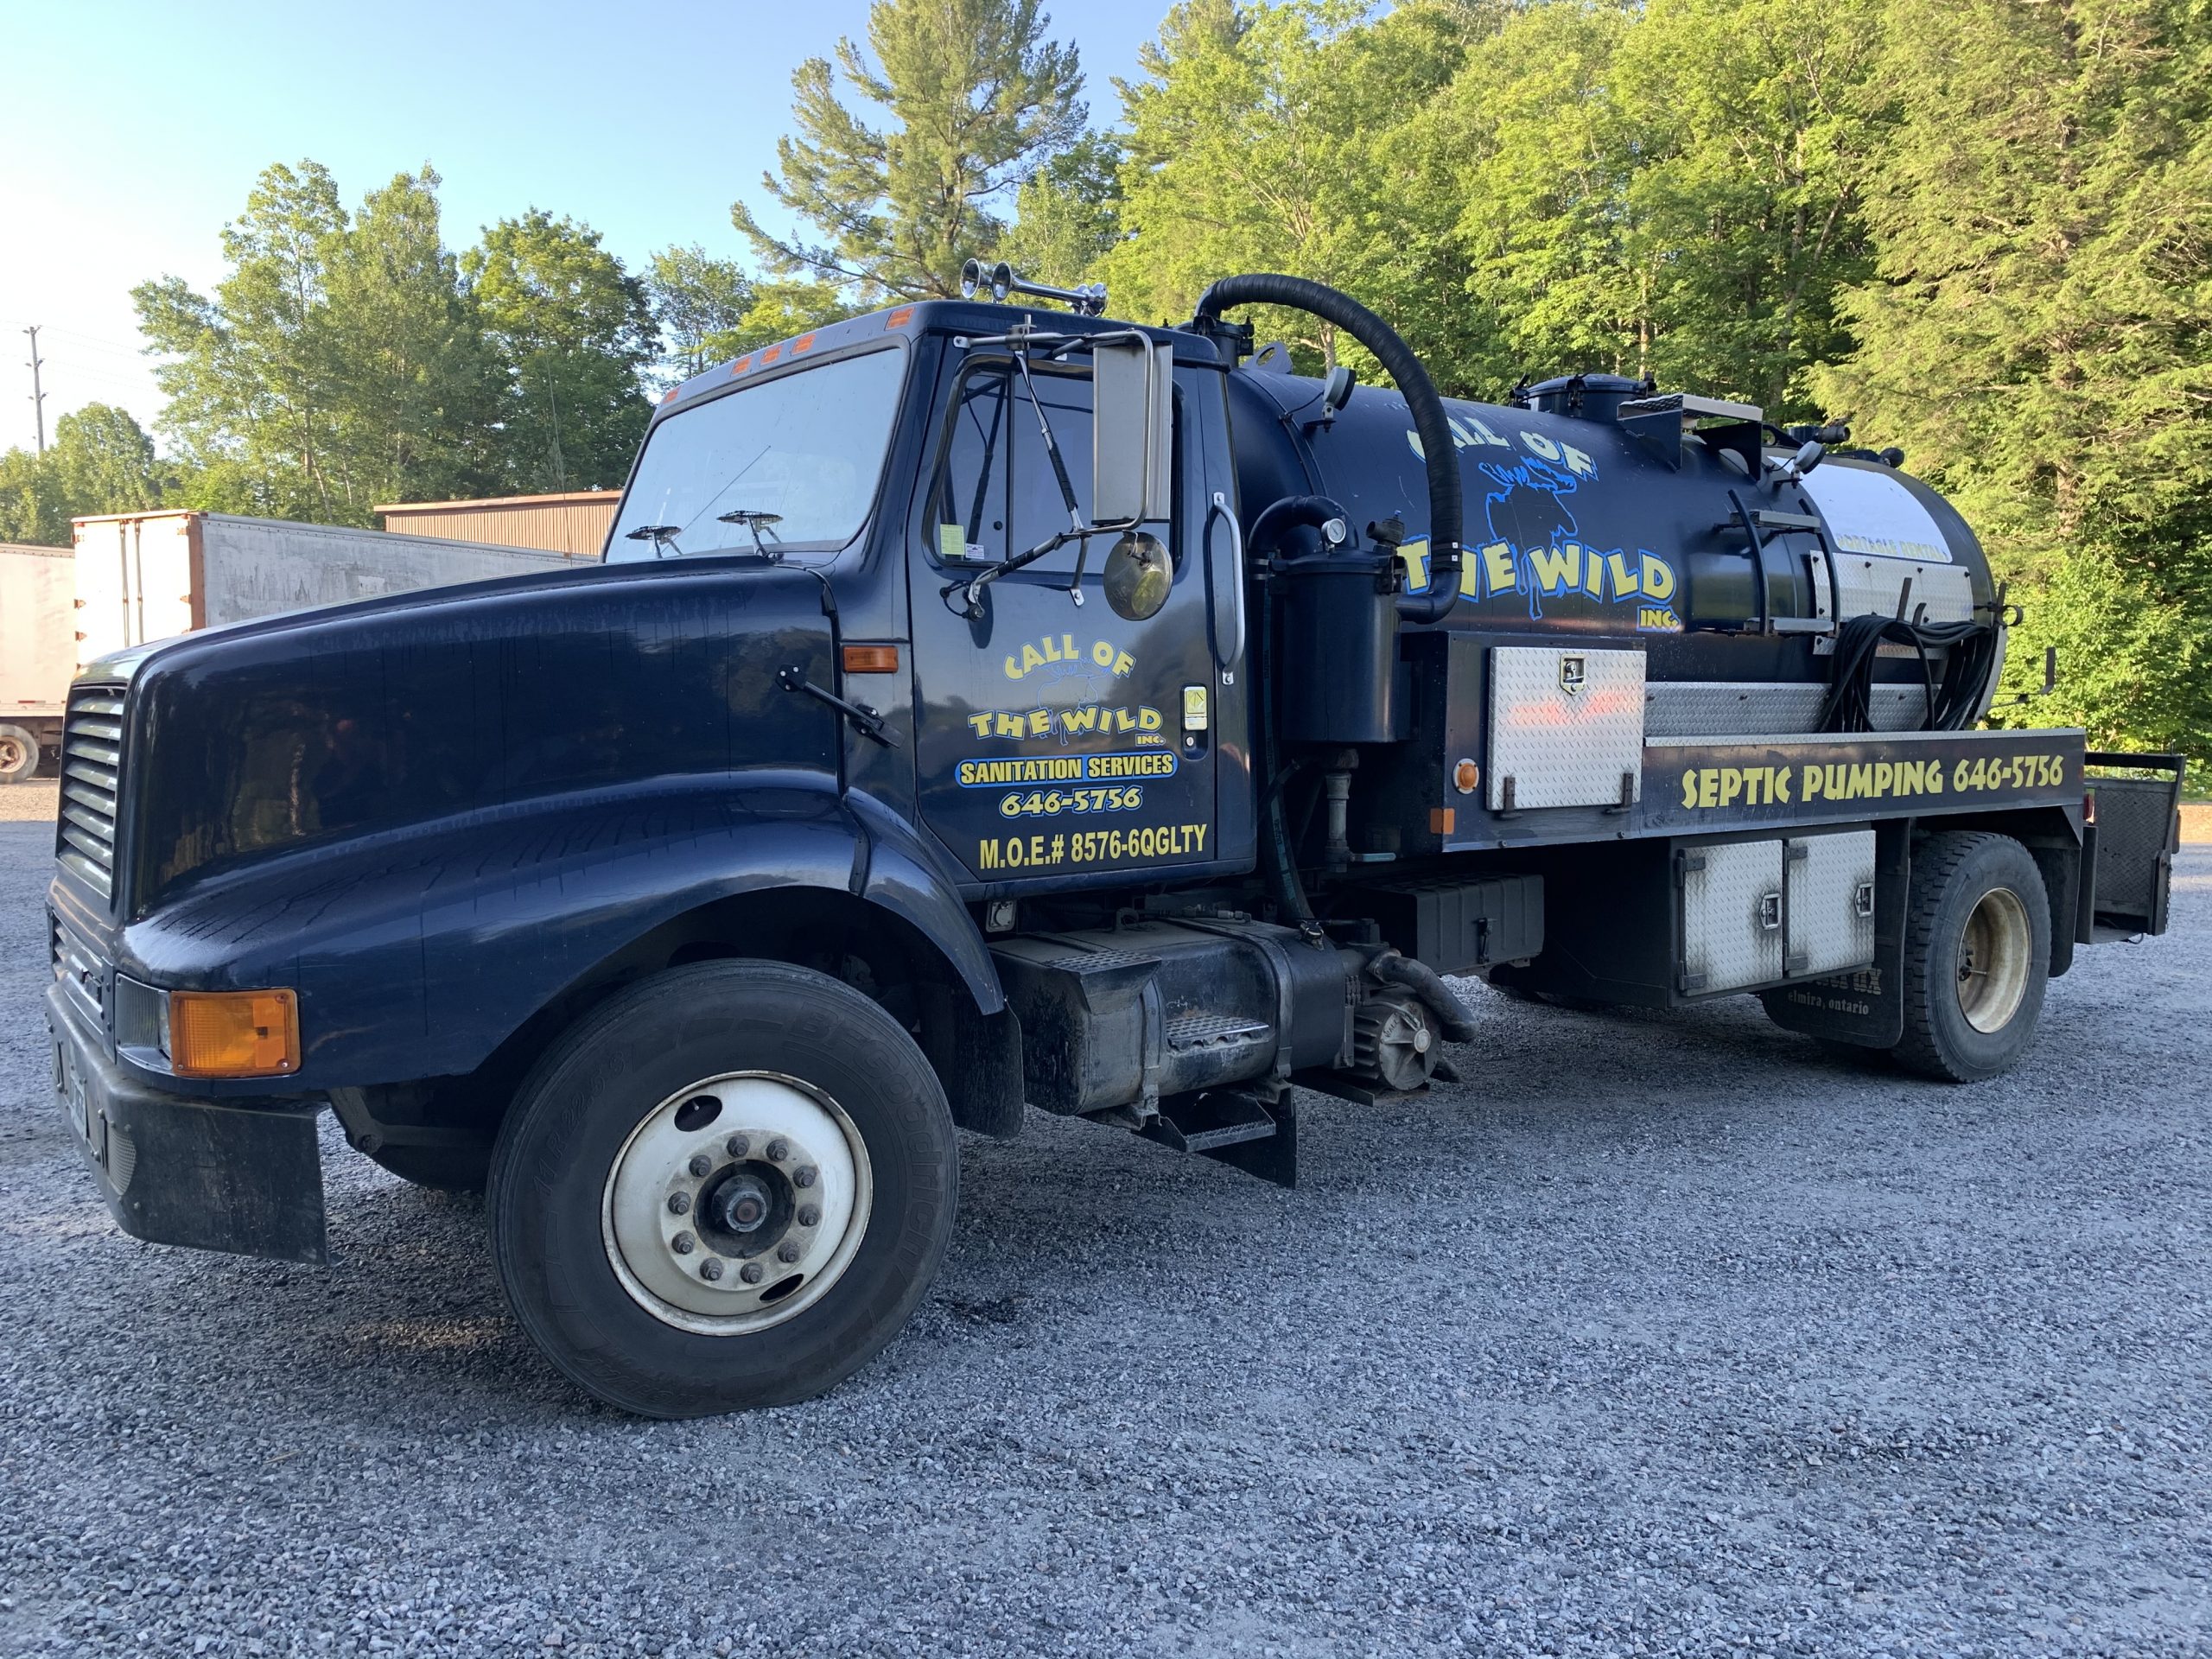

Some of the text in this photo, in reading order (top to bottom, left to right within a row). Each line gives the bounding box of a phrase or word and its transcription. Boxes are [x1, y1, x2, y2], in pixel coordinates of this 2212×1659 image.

[1520, 430, 1595, 475] OF
[1528, 543, 1675, 600] WILD
[1004, 634, 1135, 680] CALL OF
[969, 706, 1162, 740] THE WILD
[960, 753, 1174, 785] SANITATION SERVICES
[1681, 754, 2065, 810] SEPTIC PUMPING 646-5756
[1000, 786, 1142, 817] 646-5756
[979, 823, 1208, 870] M.O.E.# 8576-6QGLTY
[1788, 989, 1870, 1015] elmira, ontario
